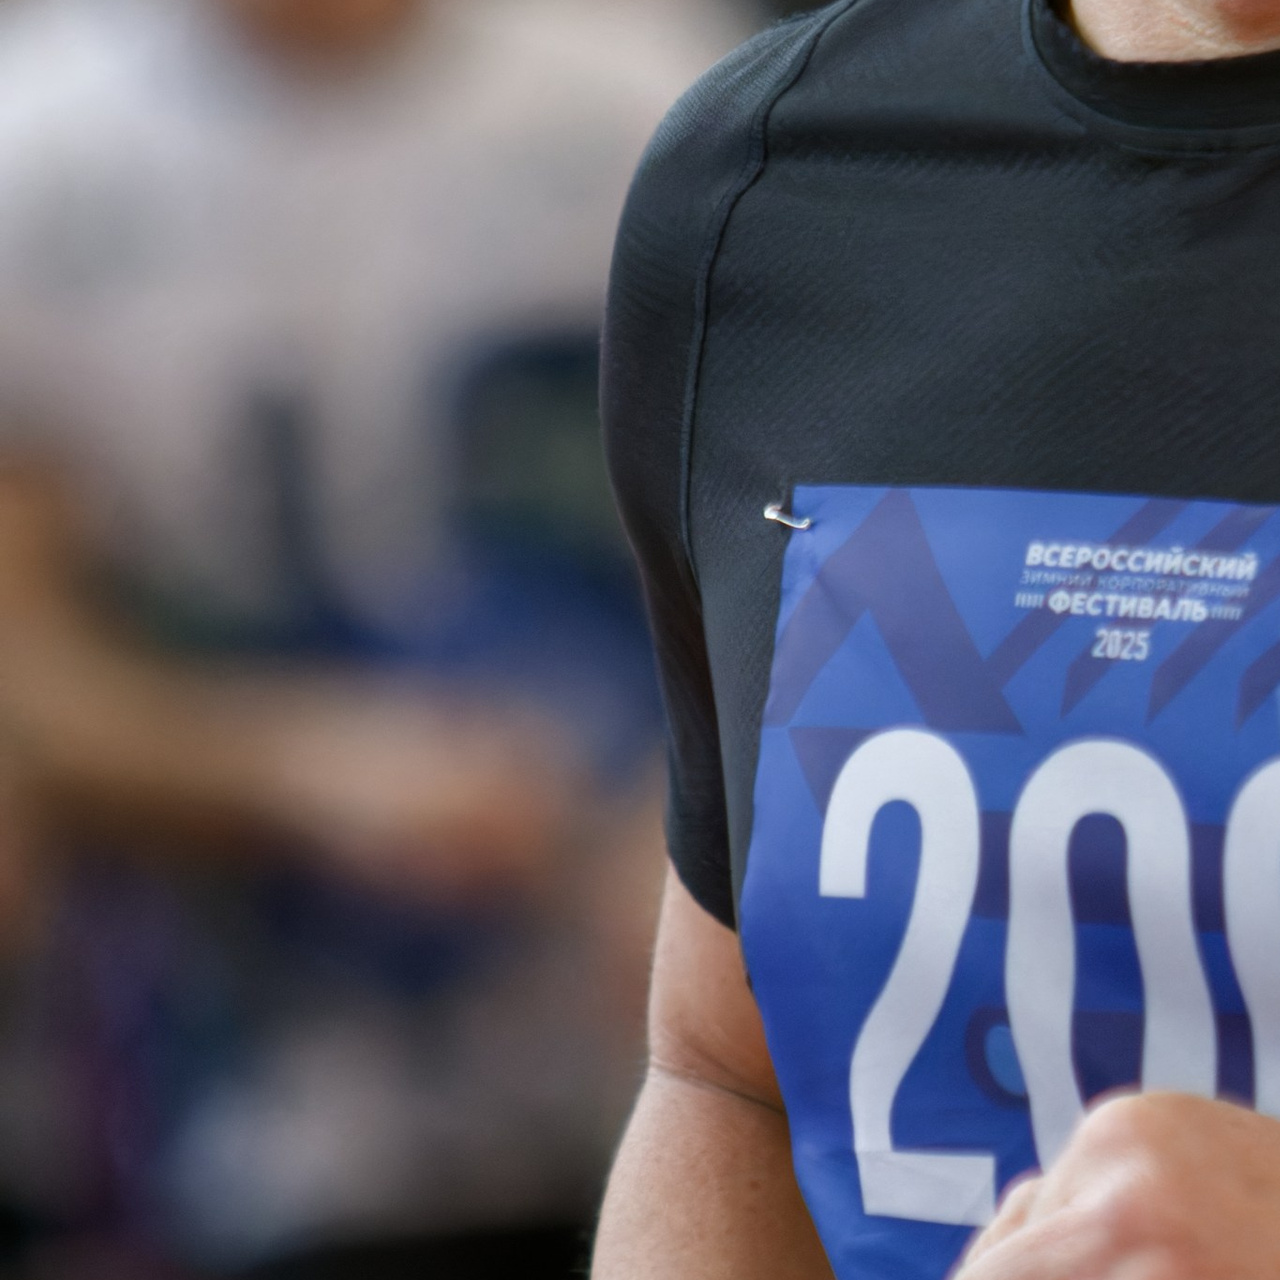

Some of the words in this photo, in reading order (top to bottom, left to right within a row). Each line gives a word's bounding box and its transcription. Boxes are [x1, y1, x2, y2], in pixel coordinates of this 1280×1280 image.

[1026, 543, 1257, 580] ВСЕРОССИЙСКИЙ
[1049, 591, 1208, 622] ФЕСТИВАЛЬ
[1093, 629, 1150, 661] 2025
